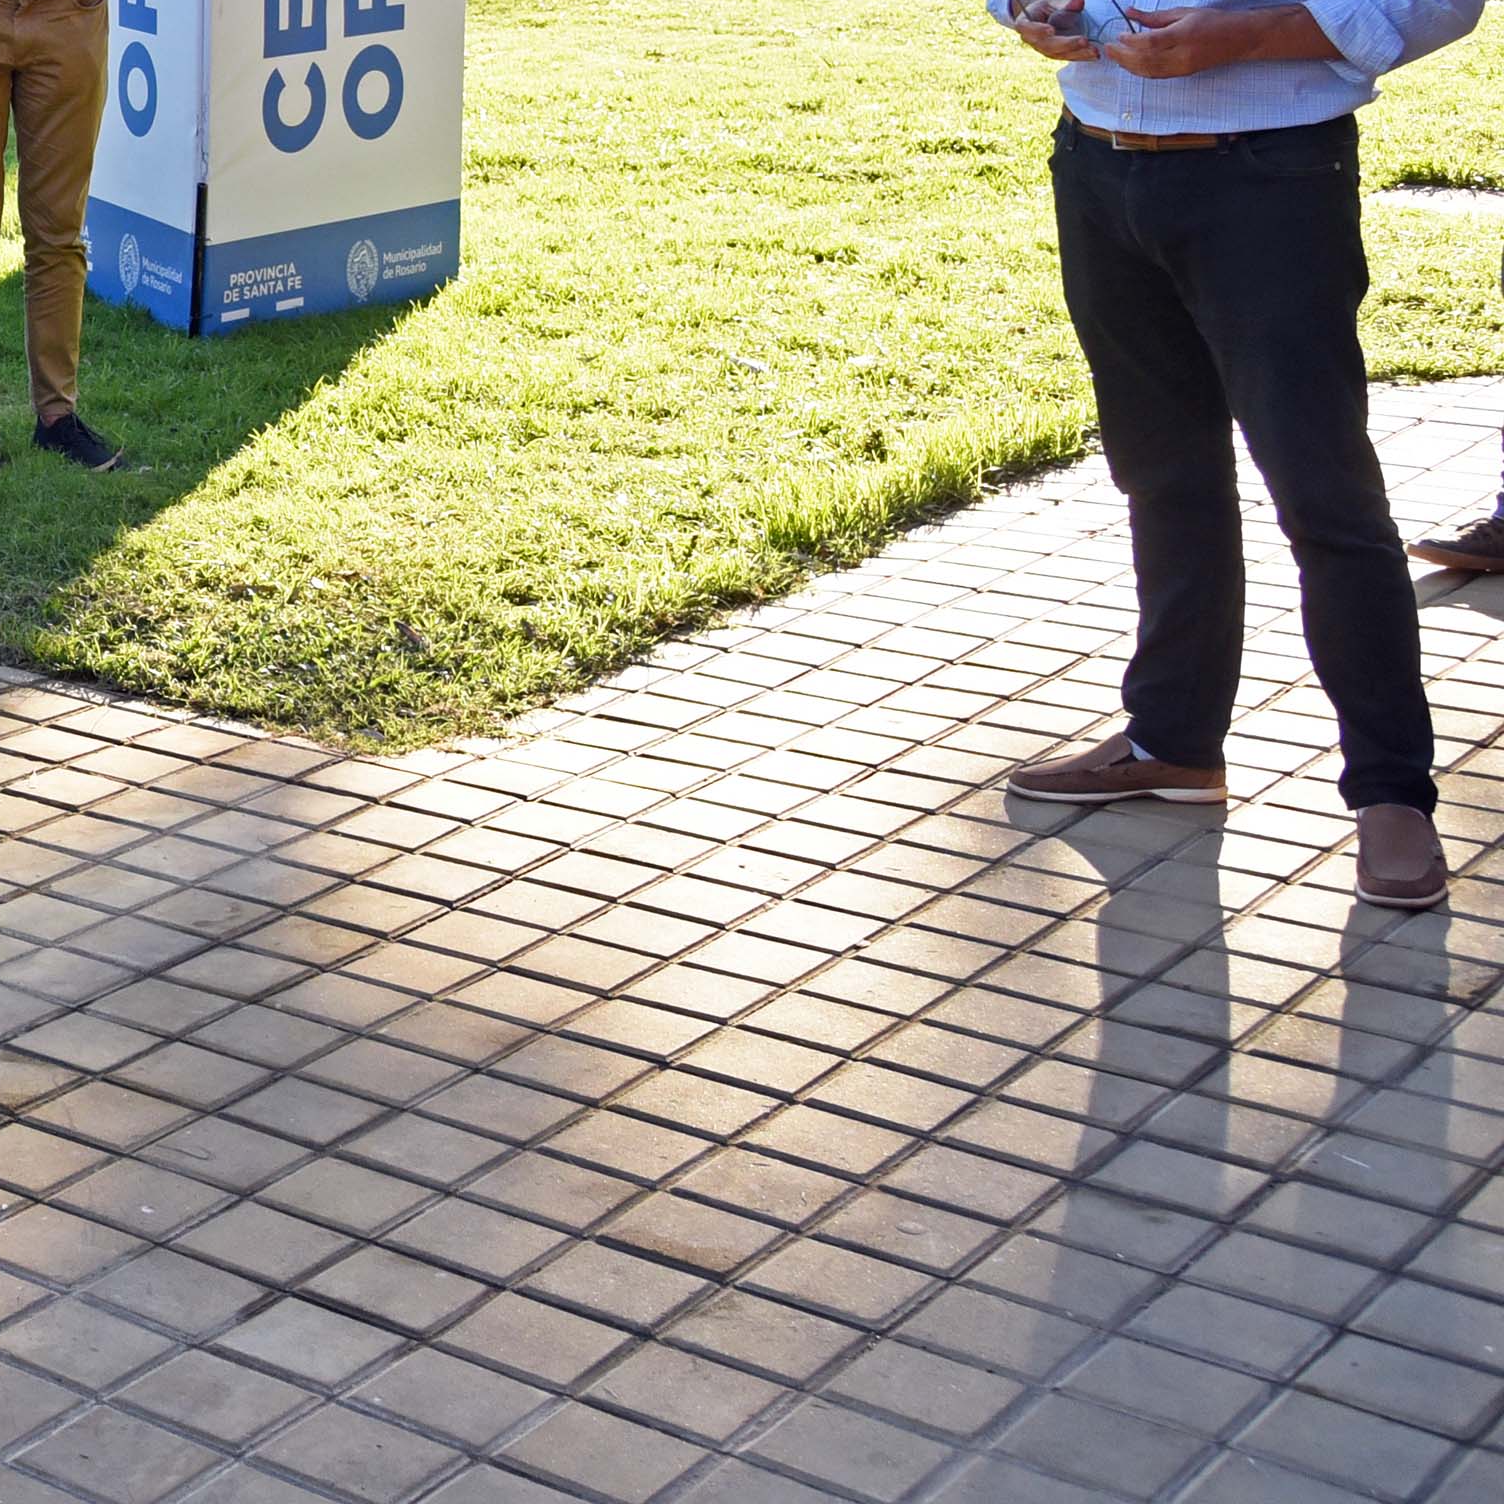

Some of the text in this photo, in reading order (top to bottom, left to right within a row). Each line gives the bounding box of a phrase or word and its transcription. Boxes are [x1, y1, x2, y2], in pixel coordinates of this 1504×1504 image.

[383, 241, 442, 264] Municipalidad
[230, 262, 296, 287] PROVINCIA
[383, 262, 426, 279] de Rosario
[224, 276, 302, 304] DE SANTA FE
